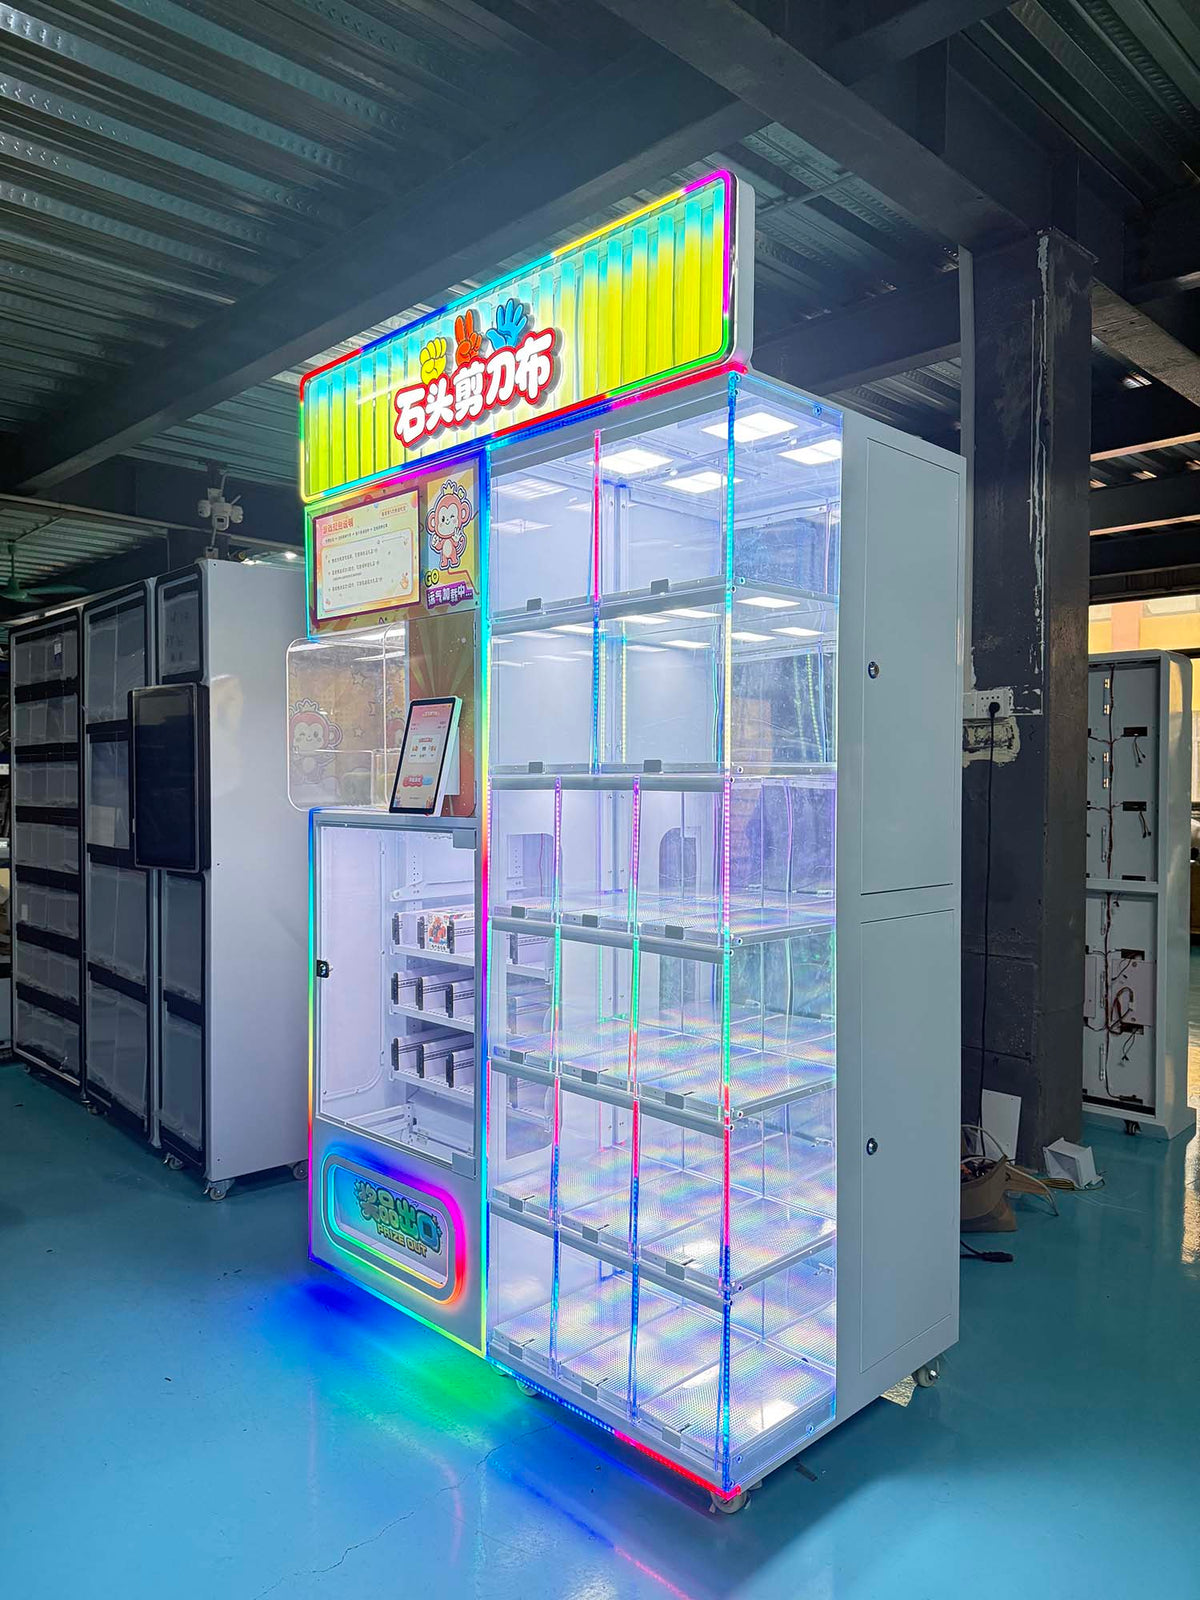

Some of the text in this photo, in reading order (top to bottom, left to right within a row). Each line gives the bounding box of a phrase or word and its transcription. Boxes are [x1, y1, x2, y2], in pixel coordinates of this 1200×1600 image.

[395, 329, 555, 446] 石头剪刀布
[424, 568, 440, 587] GO
[354, 1180, 441, 1254] 奖品出口
[377, 1223, 428, 1257] PRIZE OUT
